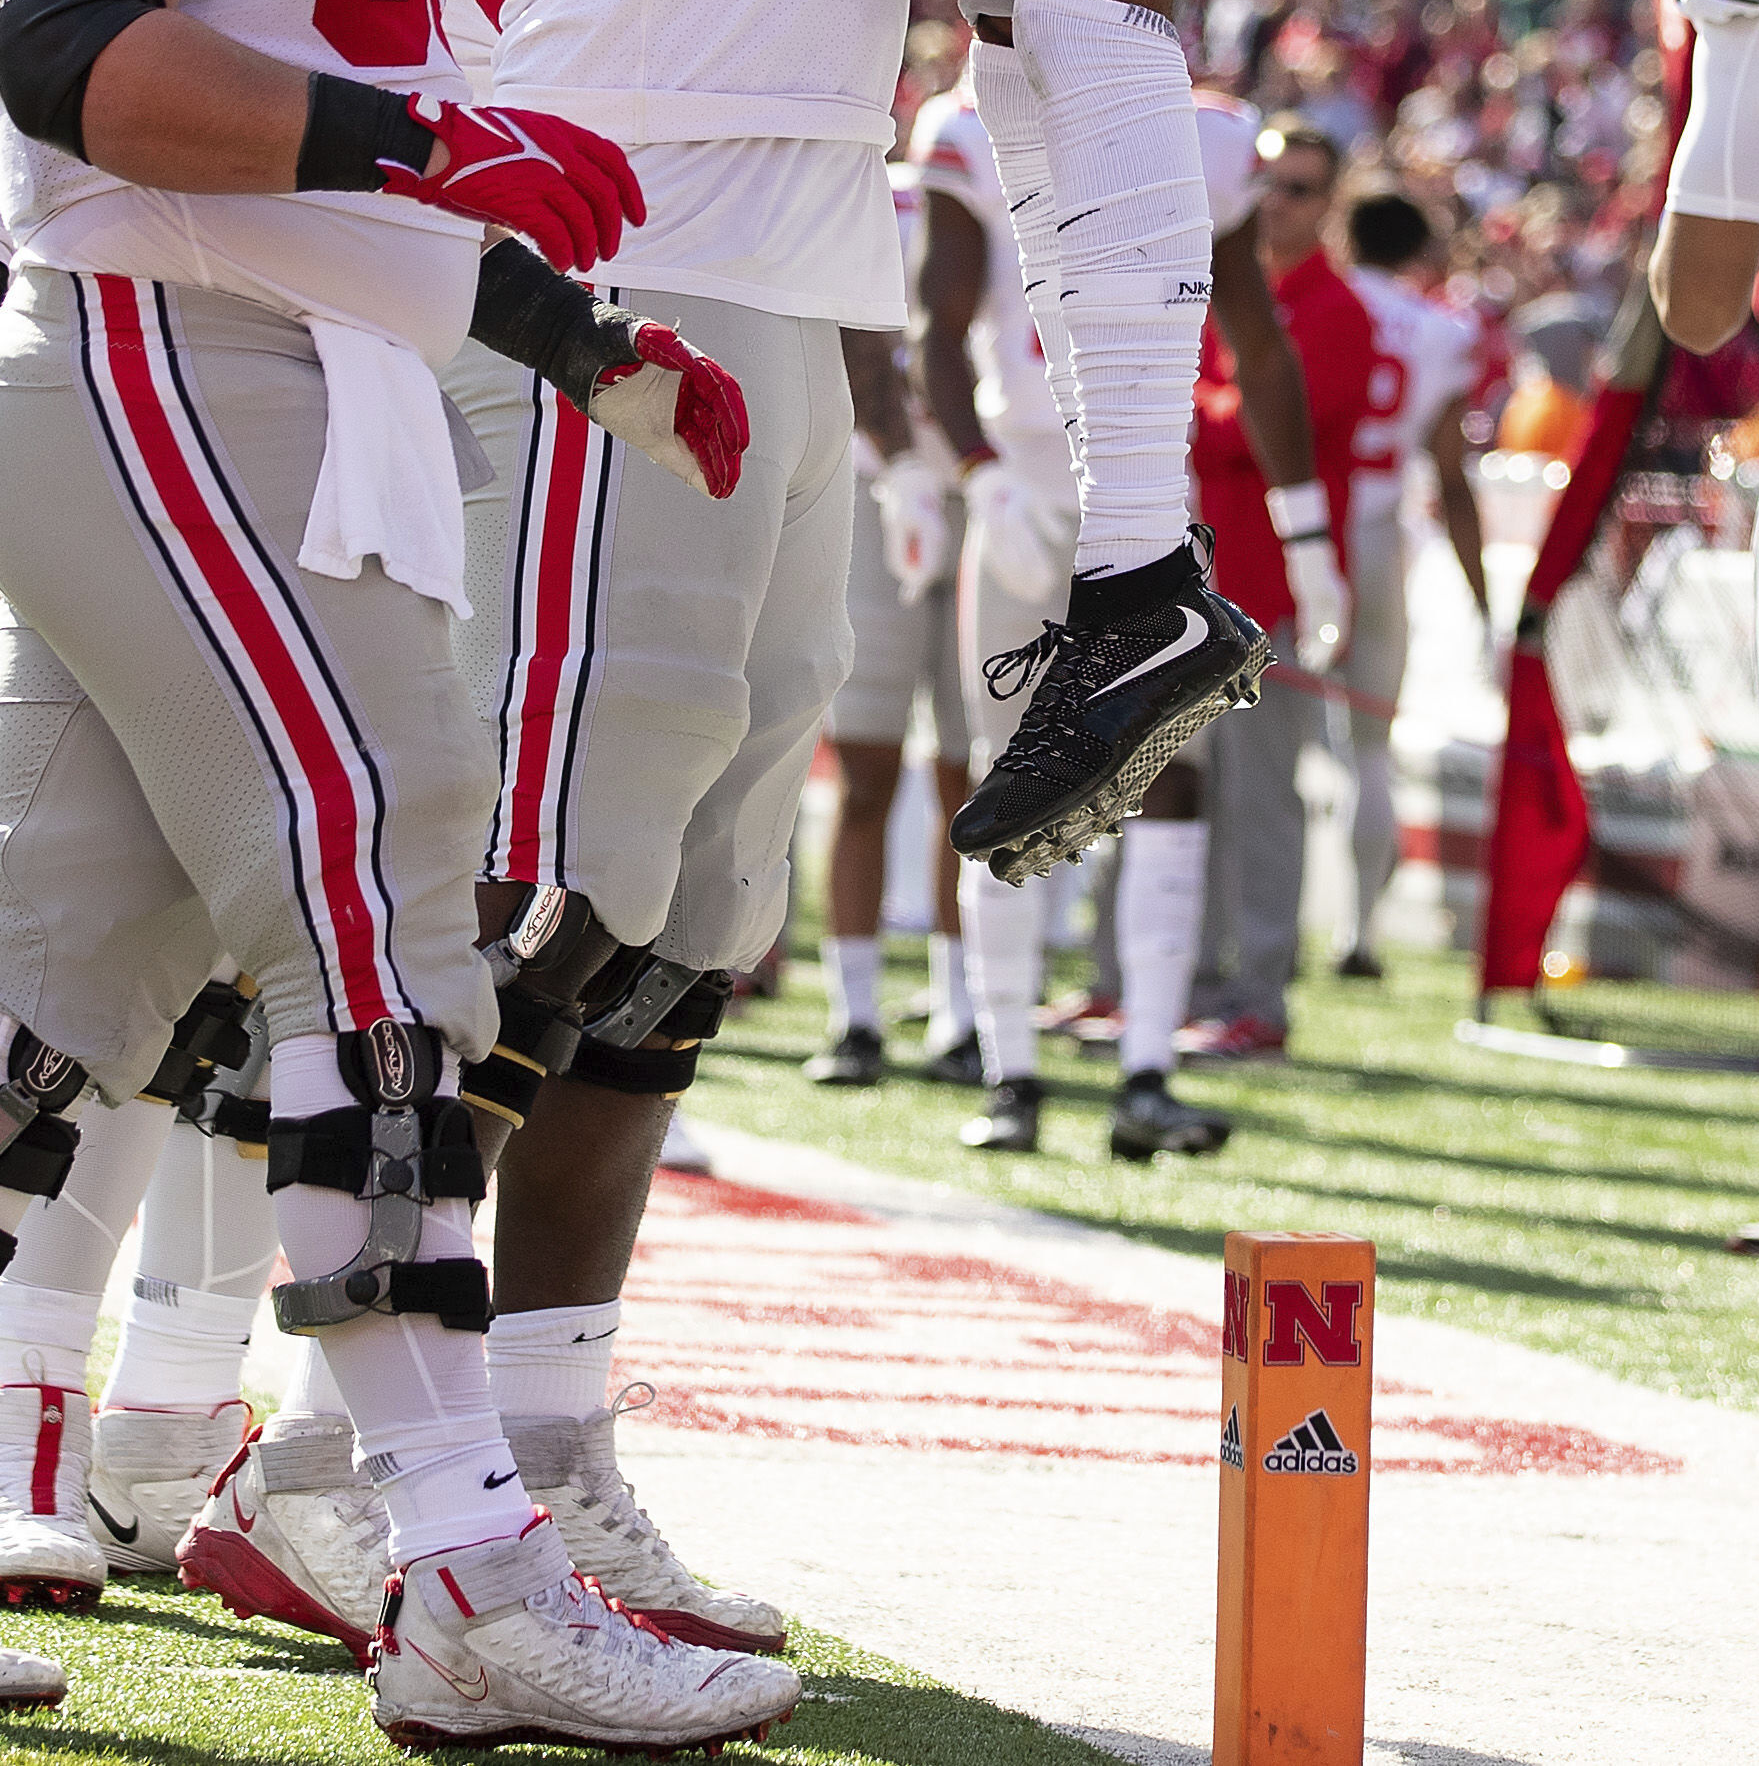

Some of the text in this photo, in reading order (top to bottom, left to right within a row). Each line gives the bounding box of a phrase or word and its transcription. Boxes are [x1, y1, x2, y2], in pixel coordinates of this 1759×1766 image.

[382, 1023, 404, 1093] DONJOY
[1223, 1268, 1249, 1364] N
[1263, 1280, 1363, 1366] N
[1264, 1448, 1357, 1474] adidas
